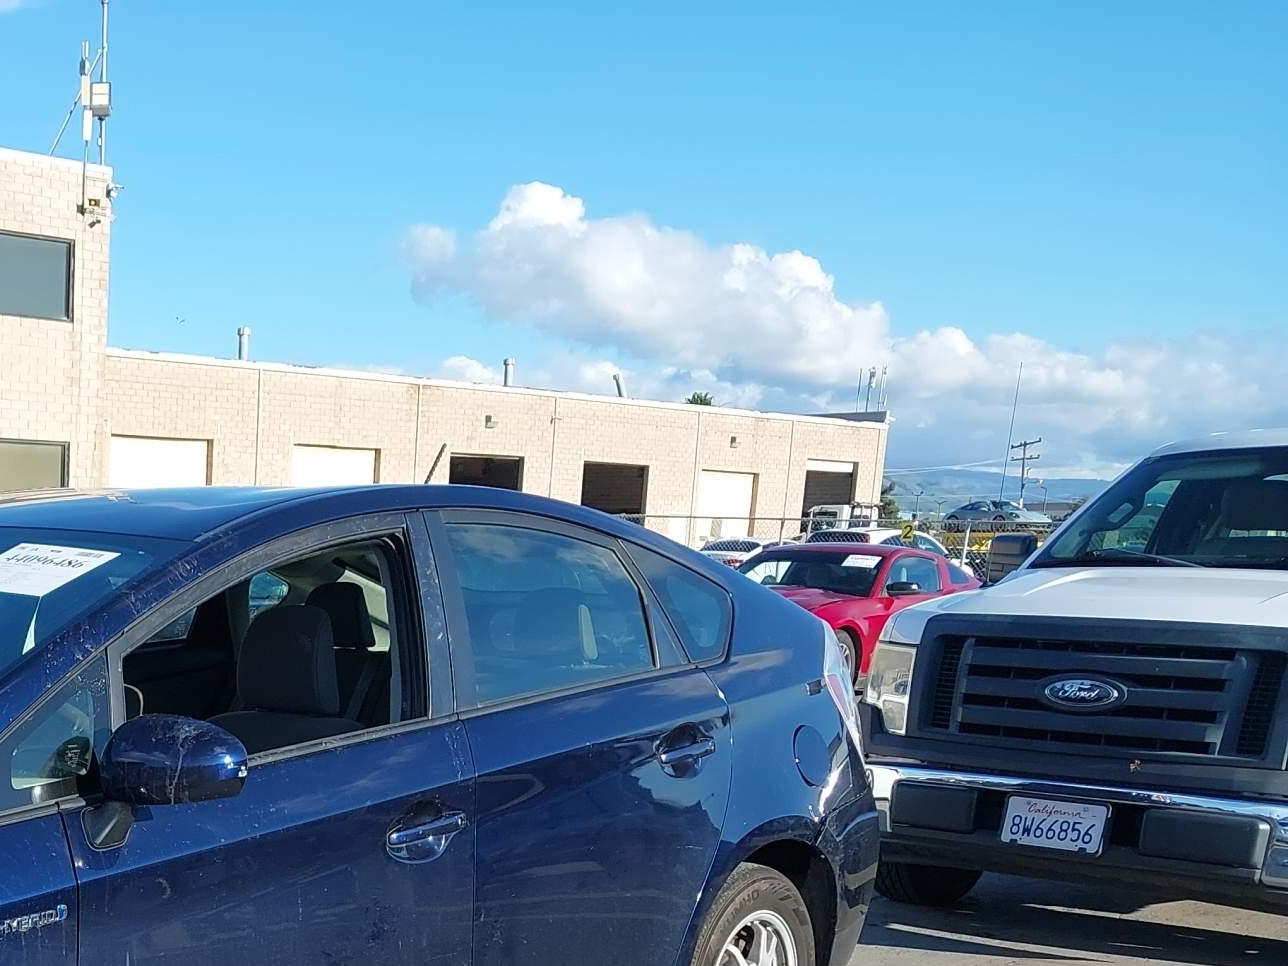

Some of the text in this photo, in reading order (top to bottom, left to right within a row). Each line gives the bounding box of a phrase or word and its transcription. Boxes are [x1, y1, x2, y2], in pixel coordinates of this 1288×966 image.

[902, 524, 913, 539] 2
[1058, 683, 1101, 700] Ford
[1028, 802, 1086, 819] California
[1010, 814, 1096, 845] 8W66856
